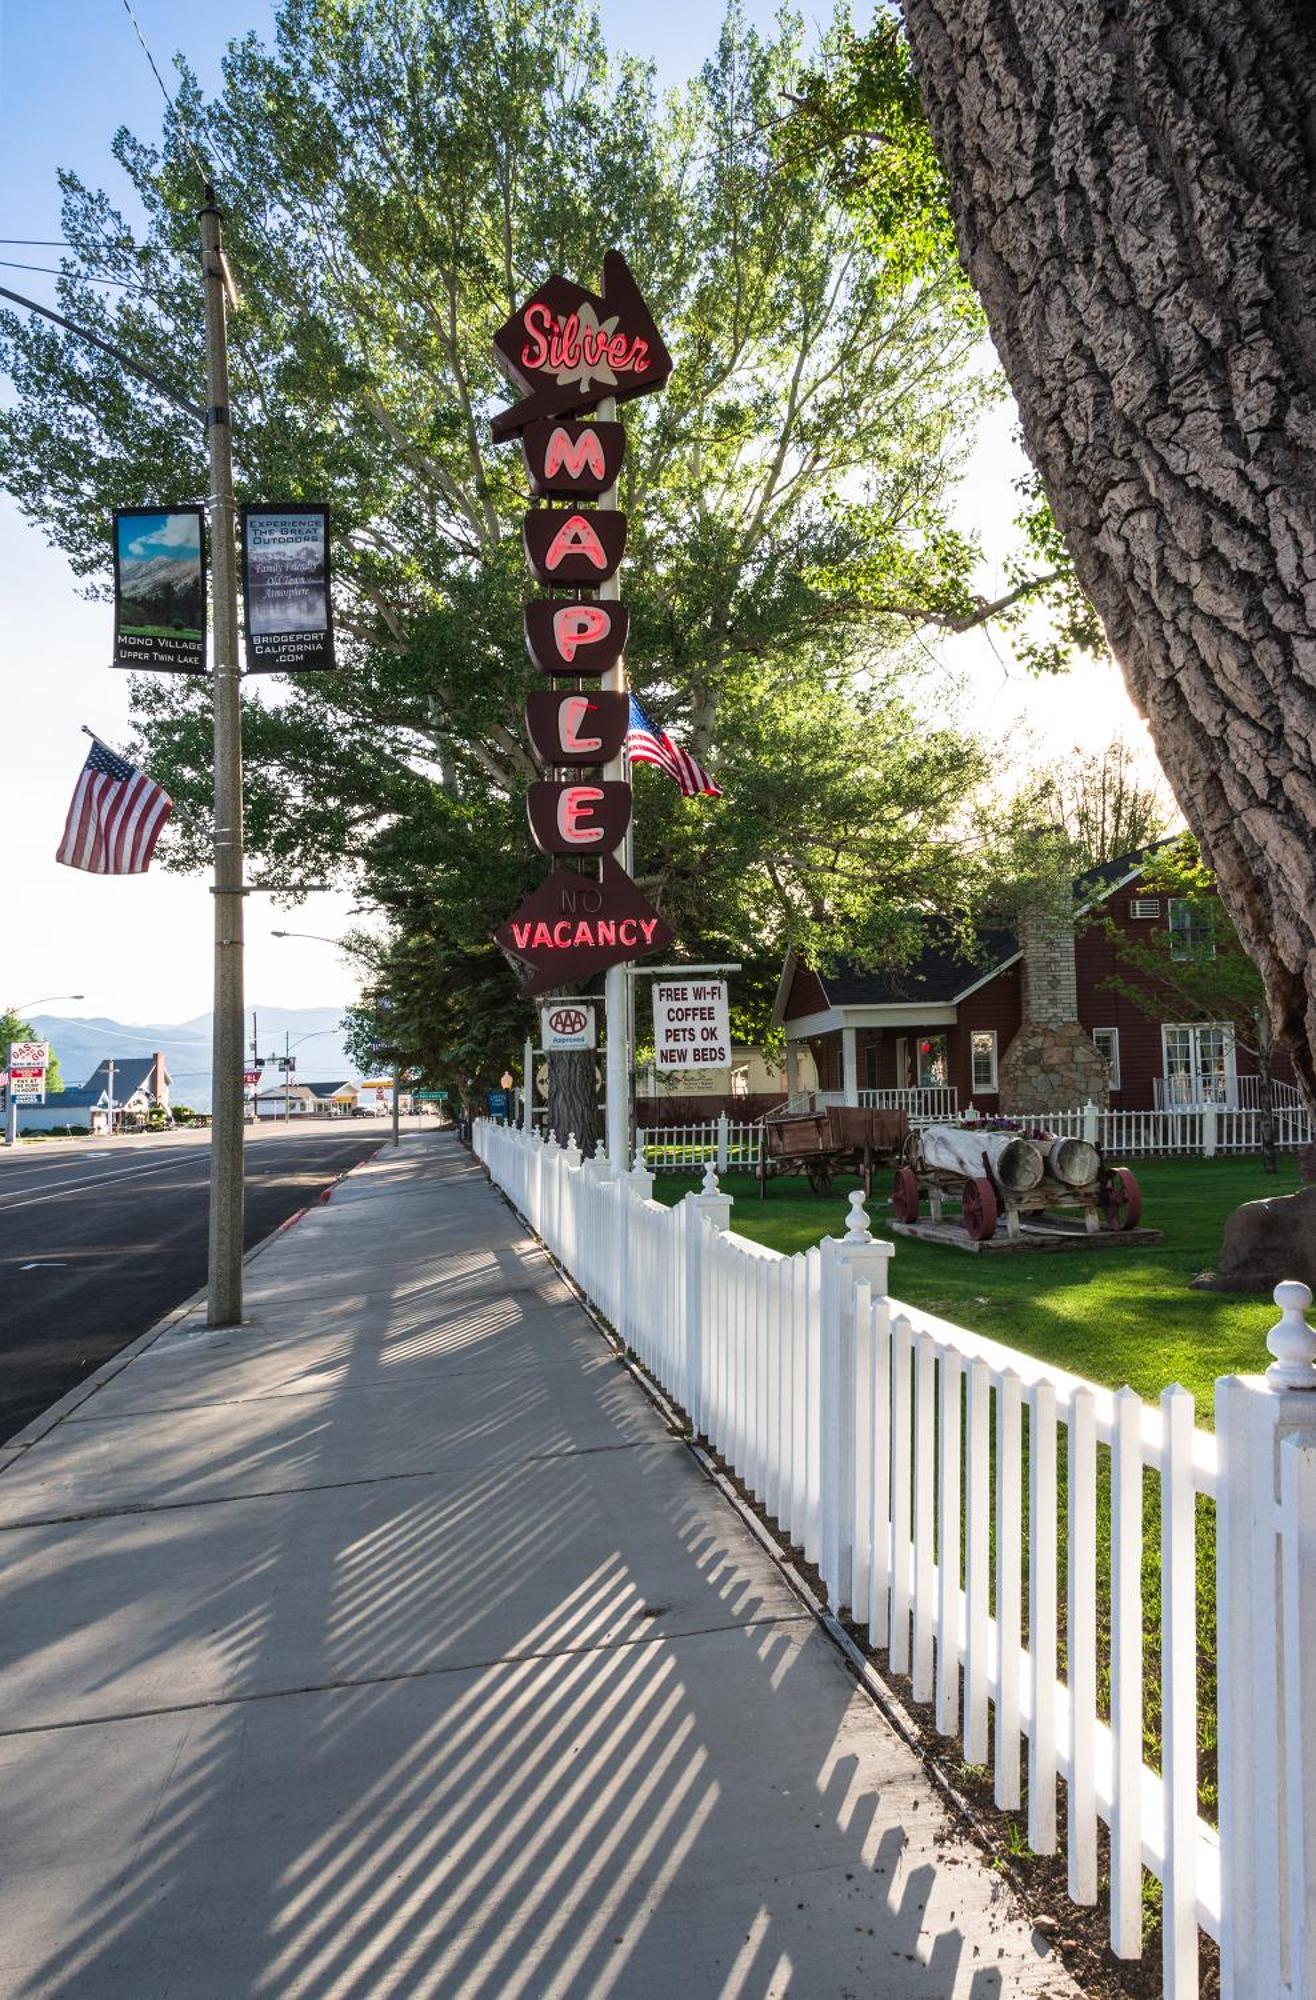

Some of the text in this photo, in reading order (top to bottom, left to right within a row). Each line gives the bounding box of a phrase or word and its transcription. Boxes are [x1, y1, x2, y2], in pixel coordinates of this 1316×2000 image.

[522, 303, 652, 373] Silver
[253, 632, 325, 645] BRIDGEPORT
[545, 427, 612, 843] MAPLE
[157, 638, 204, 651] VILLAGE
[255, 643, 324, 654] CALIFORNIA
[561, 889, 602, 913] NO
[511, 918, 658, 949] VACANCY
[659, 986, 721, 1002] FREE WI-FI
[554, 1010, 584, 1032] AAA
[667, 1006, 715, 1022] COFFEE
[665, 1026, 718, 1042] PETS OK
[660, 1046, 726, 1063] NEW BEDS
